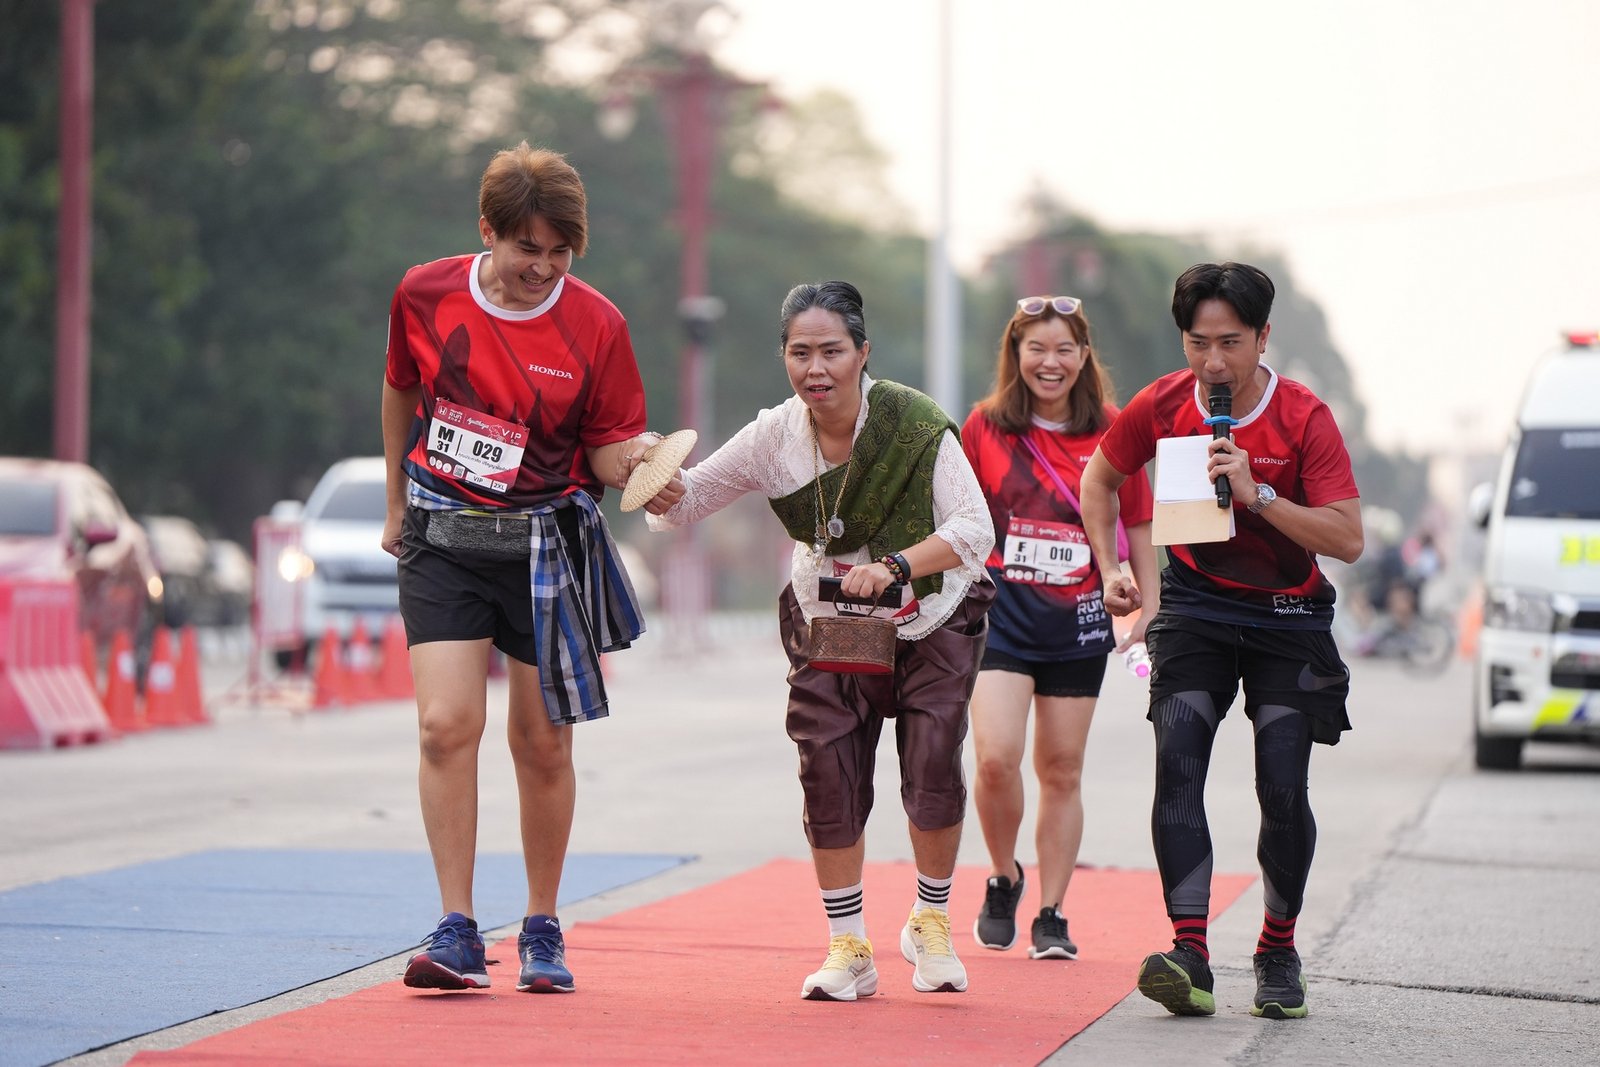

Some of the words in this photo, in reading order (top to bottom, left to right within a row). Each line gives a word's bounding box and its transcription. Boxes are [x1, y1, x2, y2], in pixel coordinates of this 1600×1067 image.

[528, 363, 574, 380] HONDA
[437, 425, 455, 443] M
[501, 428, 522, 440] VIP
[436, 440, 450, 453] 31
[472, 440, 503, 463] 029
[493, 482, 505, 491] 2XL
[1017, 541, 1027, 552] F
[1014, 553, 1027, 563] 31
[1049, 546, 1073, 562] 010
